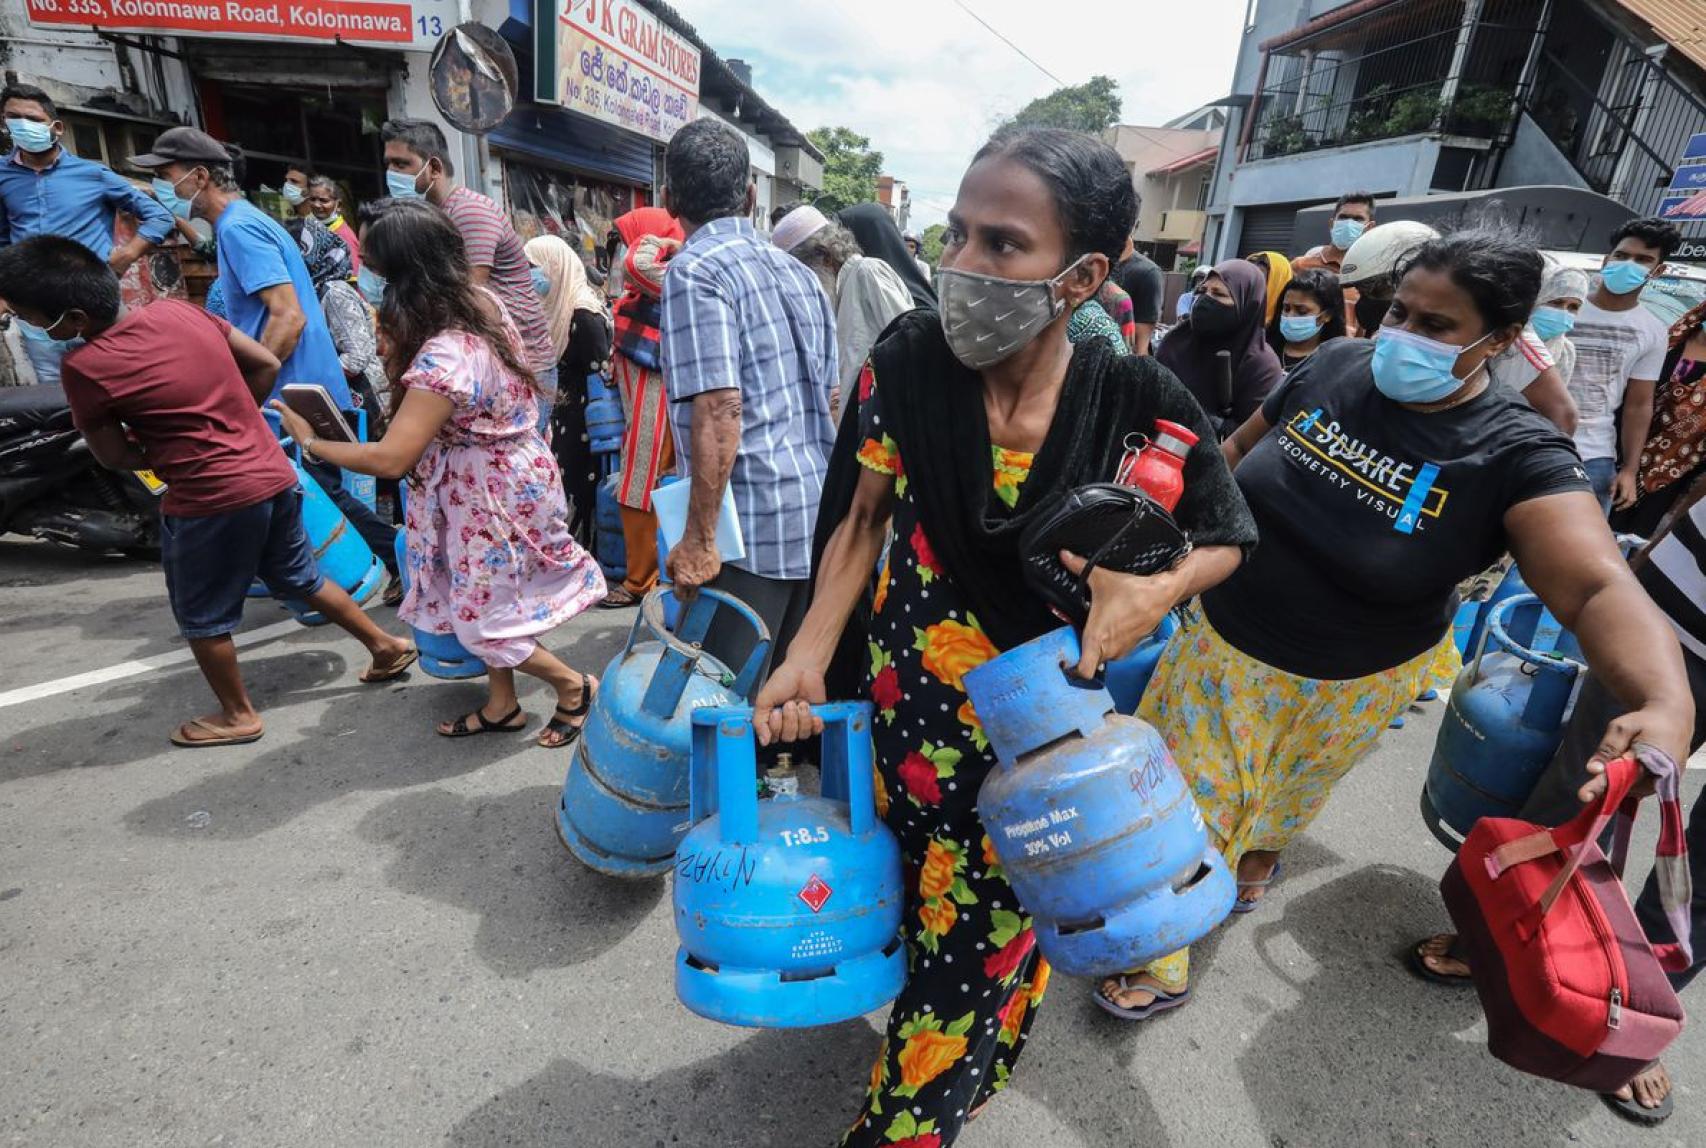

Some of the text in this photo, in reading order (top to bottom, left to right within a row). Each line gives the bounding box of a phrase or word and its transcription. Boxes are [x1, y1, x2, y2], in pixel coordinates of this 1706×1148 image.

[112, 0, 221, 21] Kolonnawa
[226, 2, 285, 28] Road,
[289, 5, 408, 33] Kolonnawa.
[417, 14, 444, 37] 13
[600, 0, 615, 37] K
[617, 6, 660, 63] GRAM
[660, 35, 699, 86] STORES
[1277, 435, 1426, 531] GEOMETRY VISUAL
[1049, 807, 1079, 824] Max
[780, 826, 830, 848] T:8.5
[1047, 830, 1073, 849] Vol
